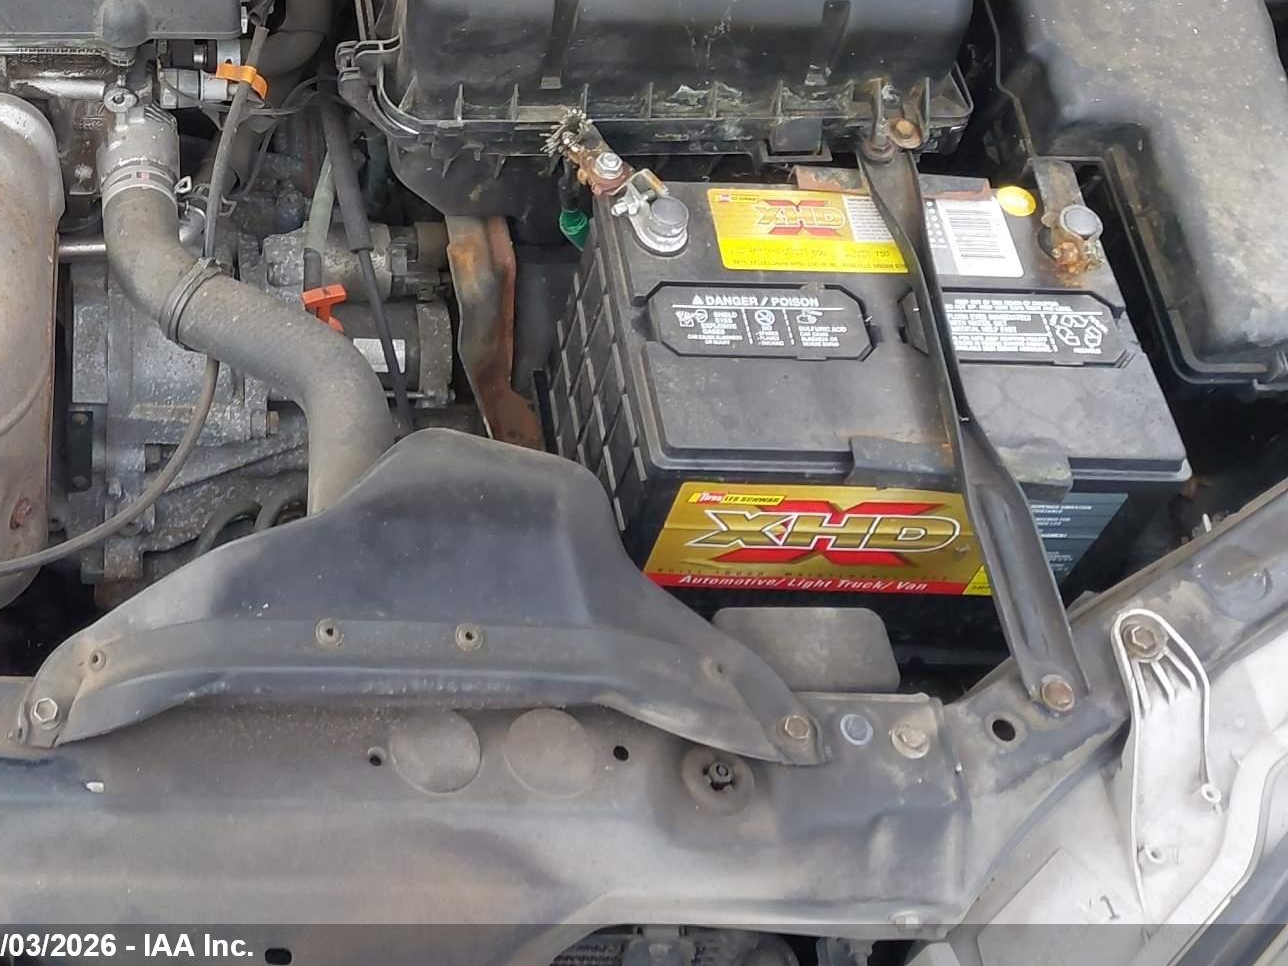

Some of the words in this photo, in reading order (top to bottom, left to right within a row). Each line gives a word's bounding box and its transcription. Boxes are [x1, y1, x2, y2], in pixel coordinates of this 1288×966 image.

[755, 206, 846, 229] XHD
[705, 296, 758, 306] DANGER
[772, 297, 819, 308] POISON
[684, 509, 961, 552] XHD
[679, 575, 786, 587] Automotive/
[787, 577, 831, 590] Light
[836, 579, 890, 591] Truck/
[894, 581, 929, 591] Van
